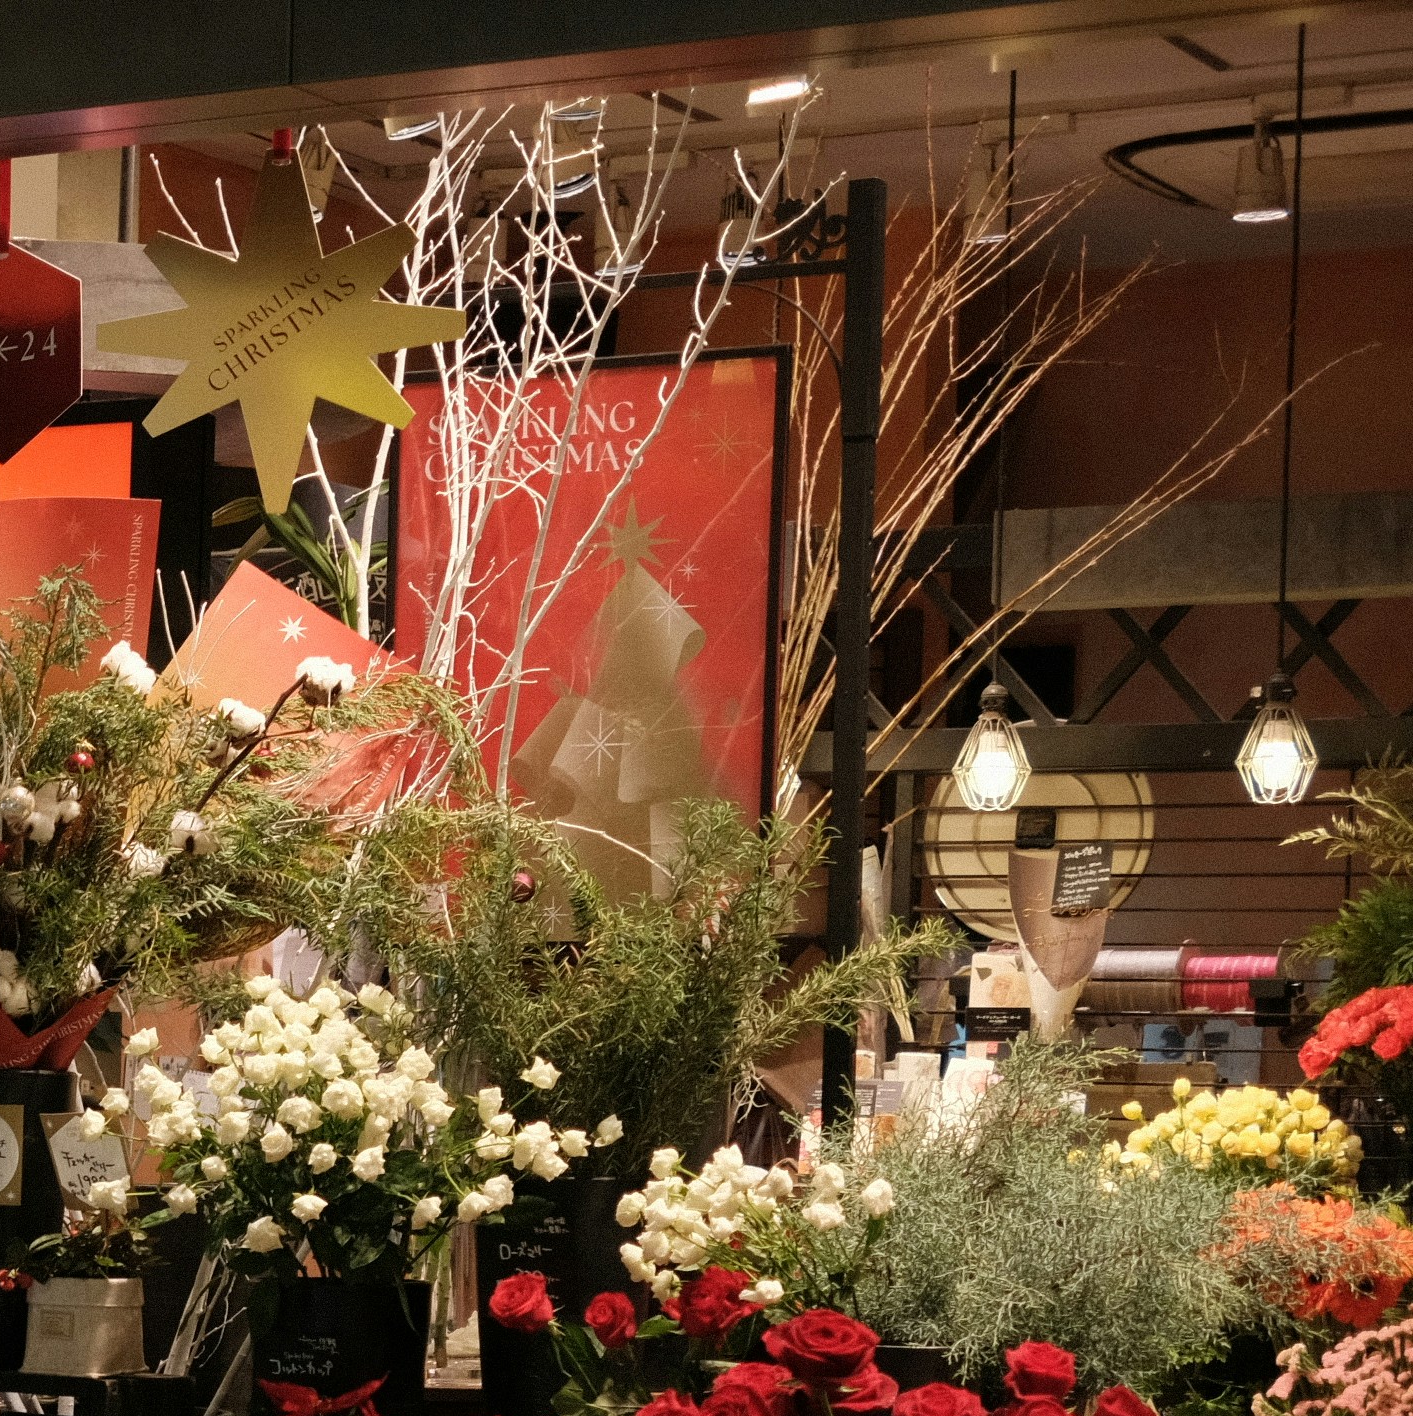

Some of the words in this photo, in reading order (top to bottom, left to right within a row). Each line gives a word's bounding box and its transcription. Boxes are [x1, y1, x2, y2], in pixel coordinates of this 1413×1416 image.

[207, 274, 357, 391] CHRISTMAS
[213, 267, 323, 353] SPARKLING
[428, 401, 636, 445] SAKLING
[425, 438, 644, 482] CHISTMAS
